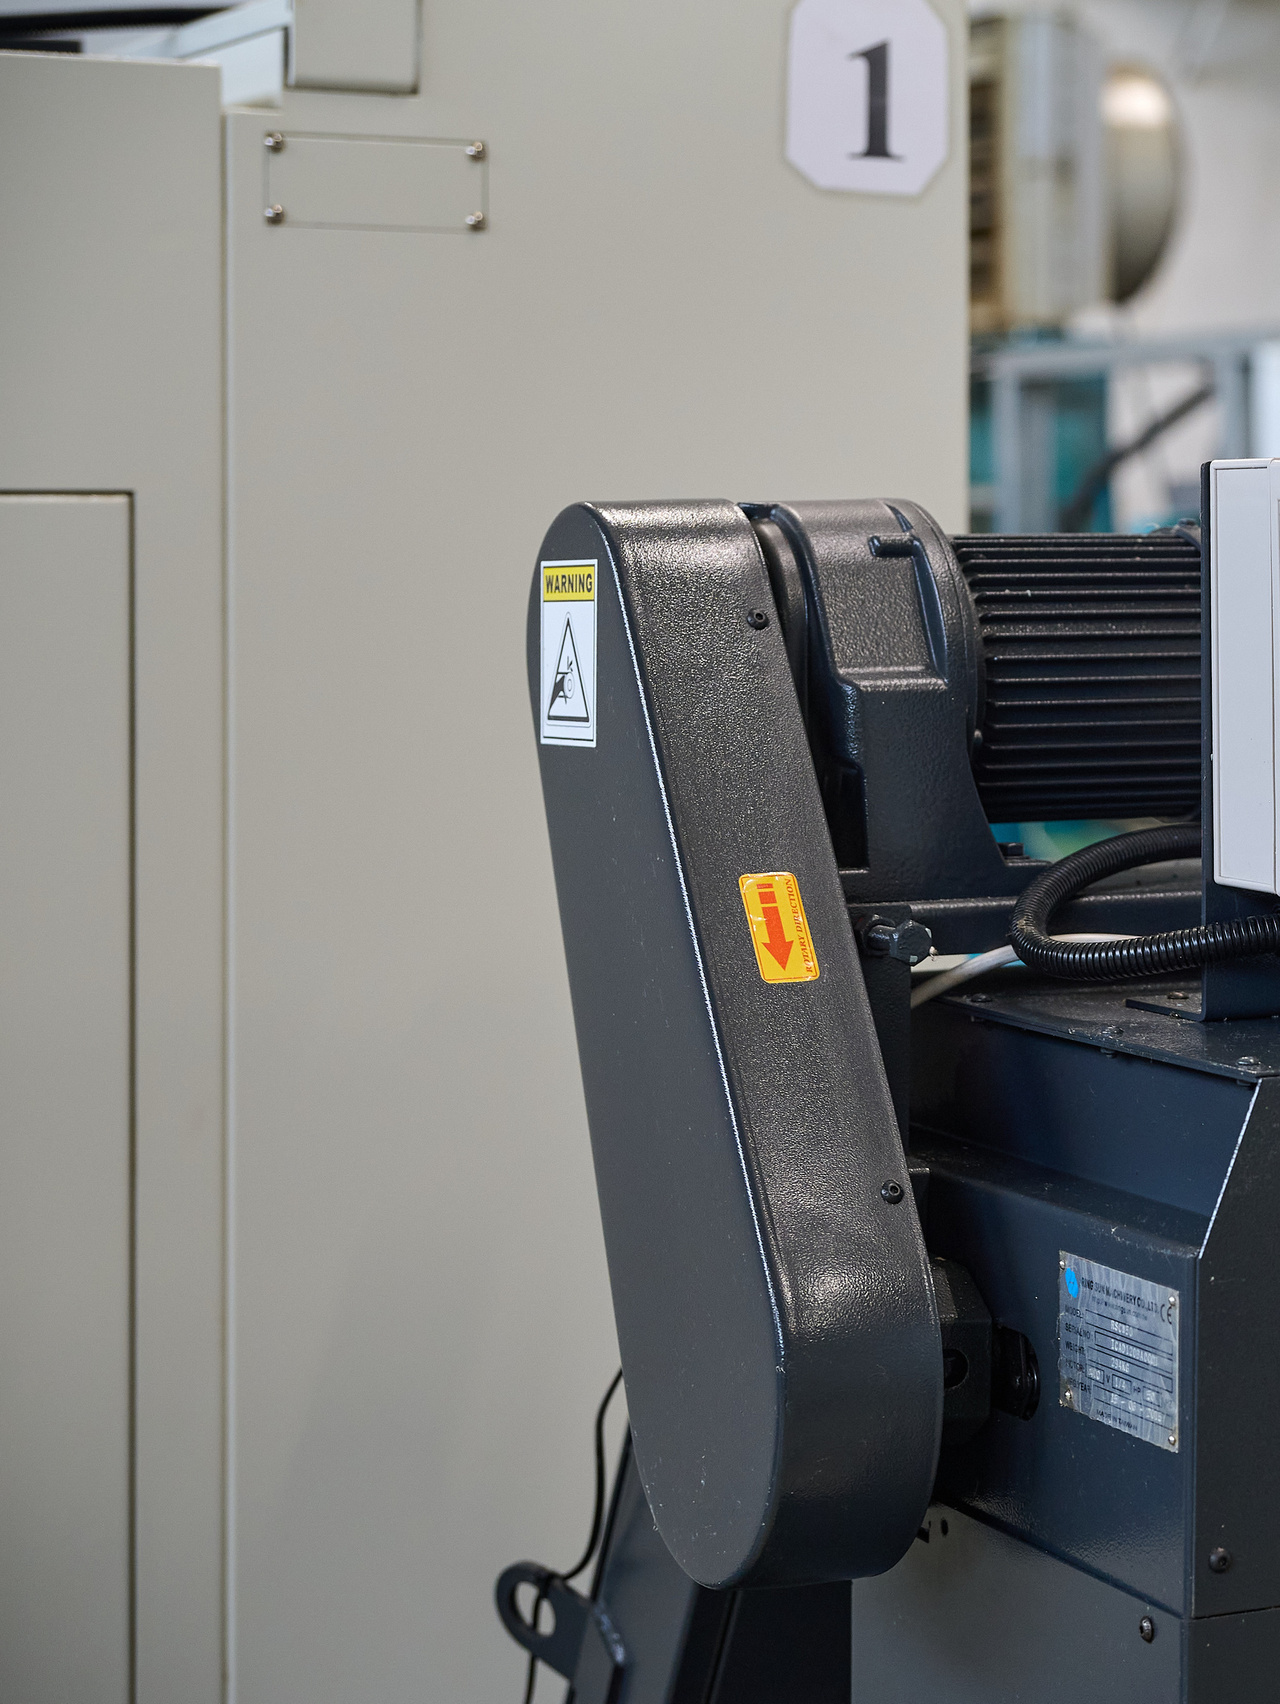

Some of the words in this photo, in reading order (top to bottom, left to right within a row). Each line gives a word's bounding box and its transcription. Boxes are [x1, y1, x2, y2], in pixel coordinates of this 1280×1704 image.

[849, 39, 904, 161] 1
[546, 574, 592, 593] WARNING
[784, 878, 802, 932] DIRECTION
[798, 936, 813, 973] ROTARY
